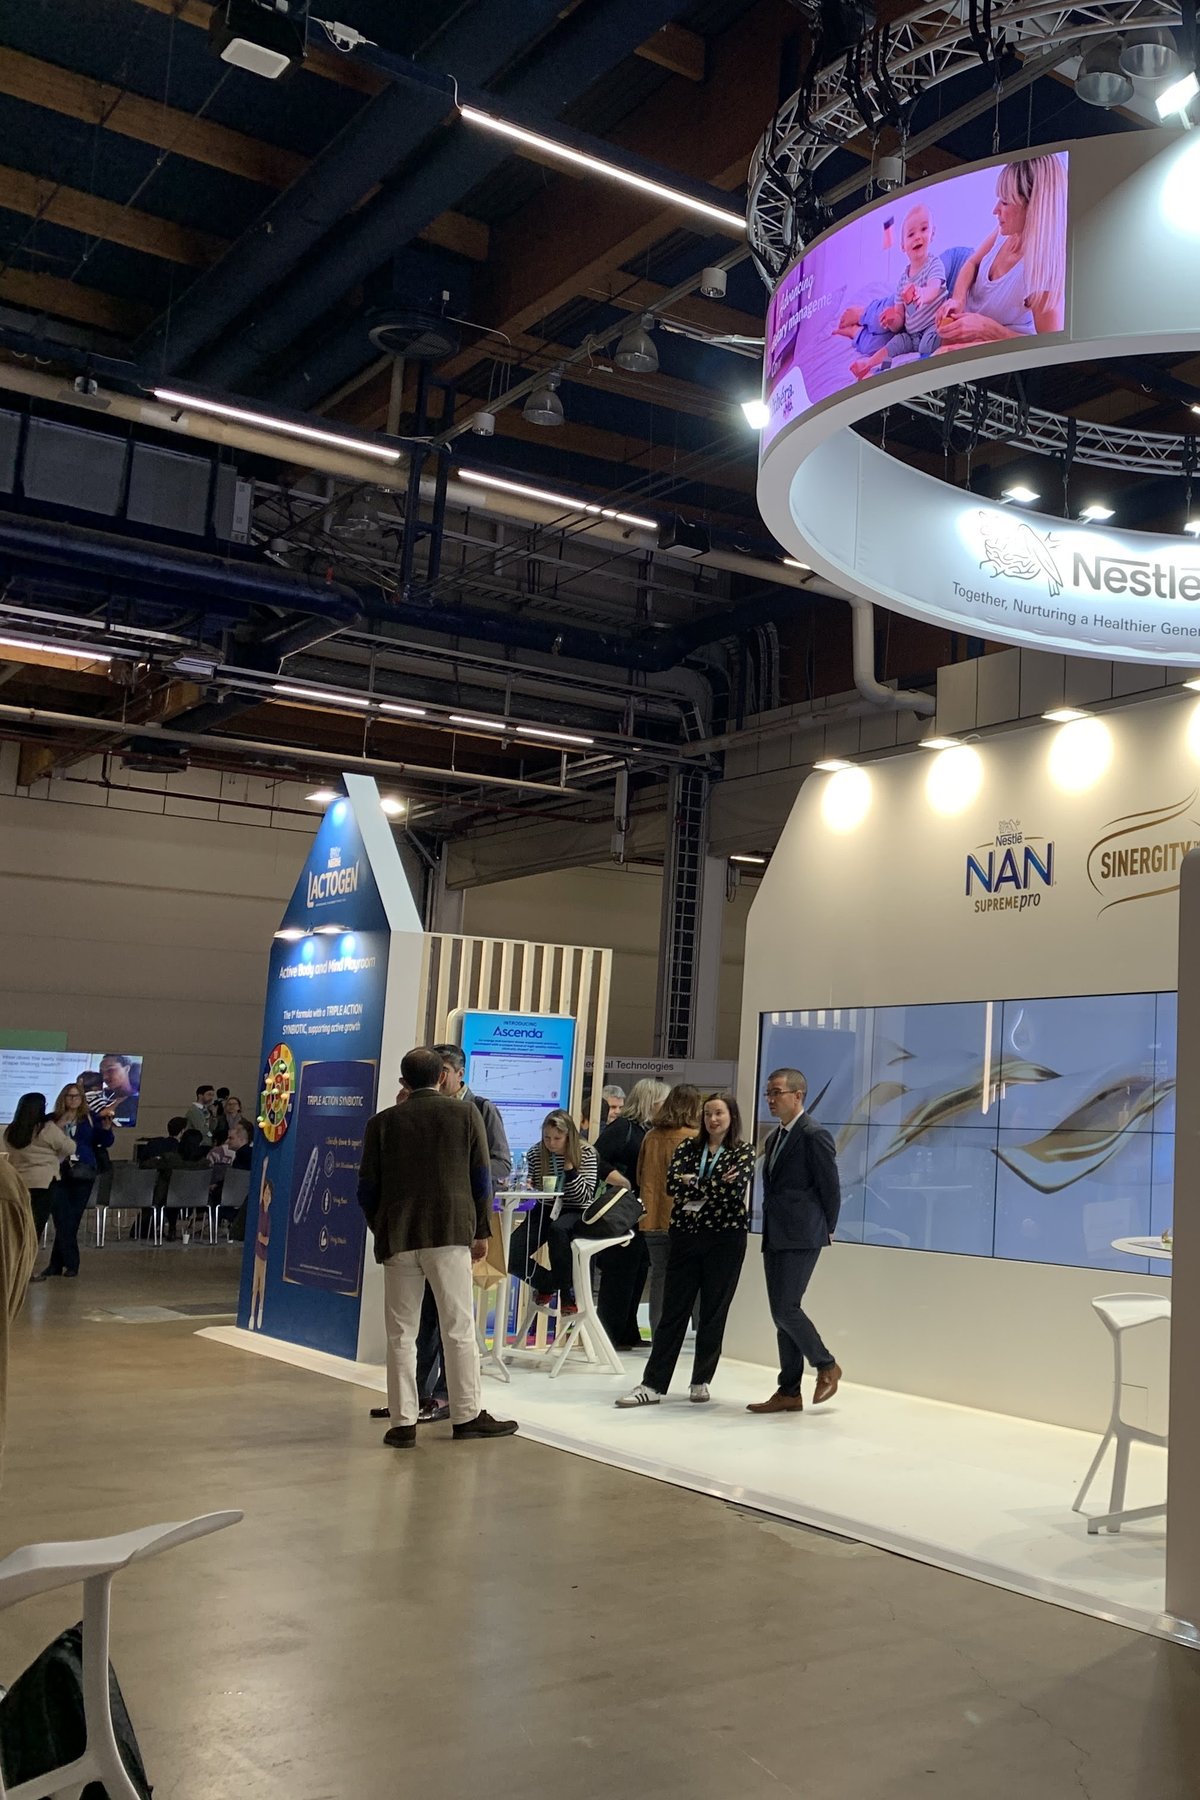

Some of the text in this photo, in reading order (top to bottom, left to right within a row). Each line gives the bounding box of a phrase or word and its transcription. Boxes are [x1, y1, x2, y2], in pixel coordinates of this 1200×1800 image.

[952, 580, 1009, 612] Together,
[1013, 598, 1077, 626] Nurturing
[1080, 615, 1089, 626] a
[1093, 614, 1156, 634] Healthier
[995, 831, 1023, 847] Nestlé
[965, 840, 1056, 897] NAN
[306, 860, 360, 909] LACTOGEN
[279, 956, 376, 979] Active Body and Mind Playroom
[326, 1004, 343, 1017] TRIPLE
[343, 1003, 364, 1016] ACTION
[308, 1023, 331, 1036] supporting
[344, 1020, 361, 1034] growth
[503, 1020, 538, 1028] INTRODUCING
[493, 1026, 544, 1039] Ascenda
[616, 1060, 675, 1073] Technologies
[307, 1095, 322, 1106] TRIPLE
[322, 1095, 339, 1106] ACTION
